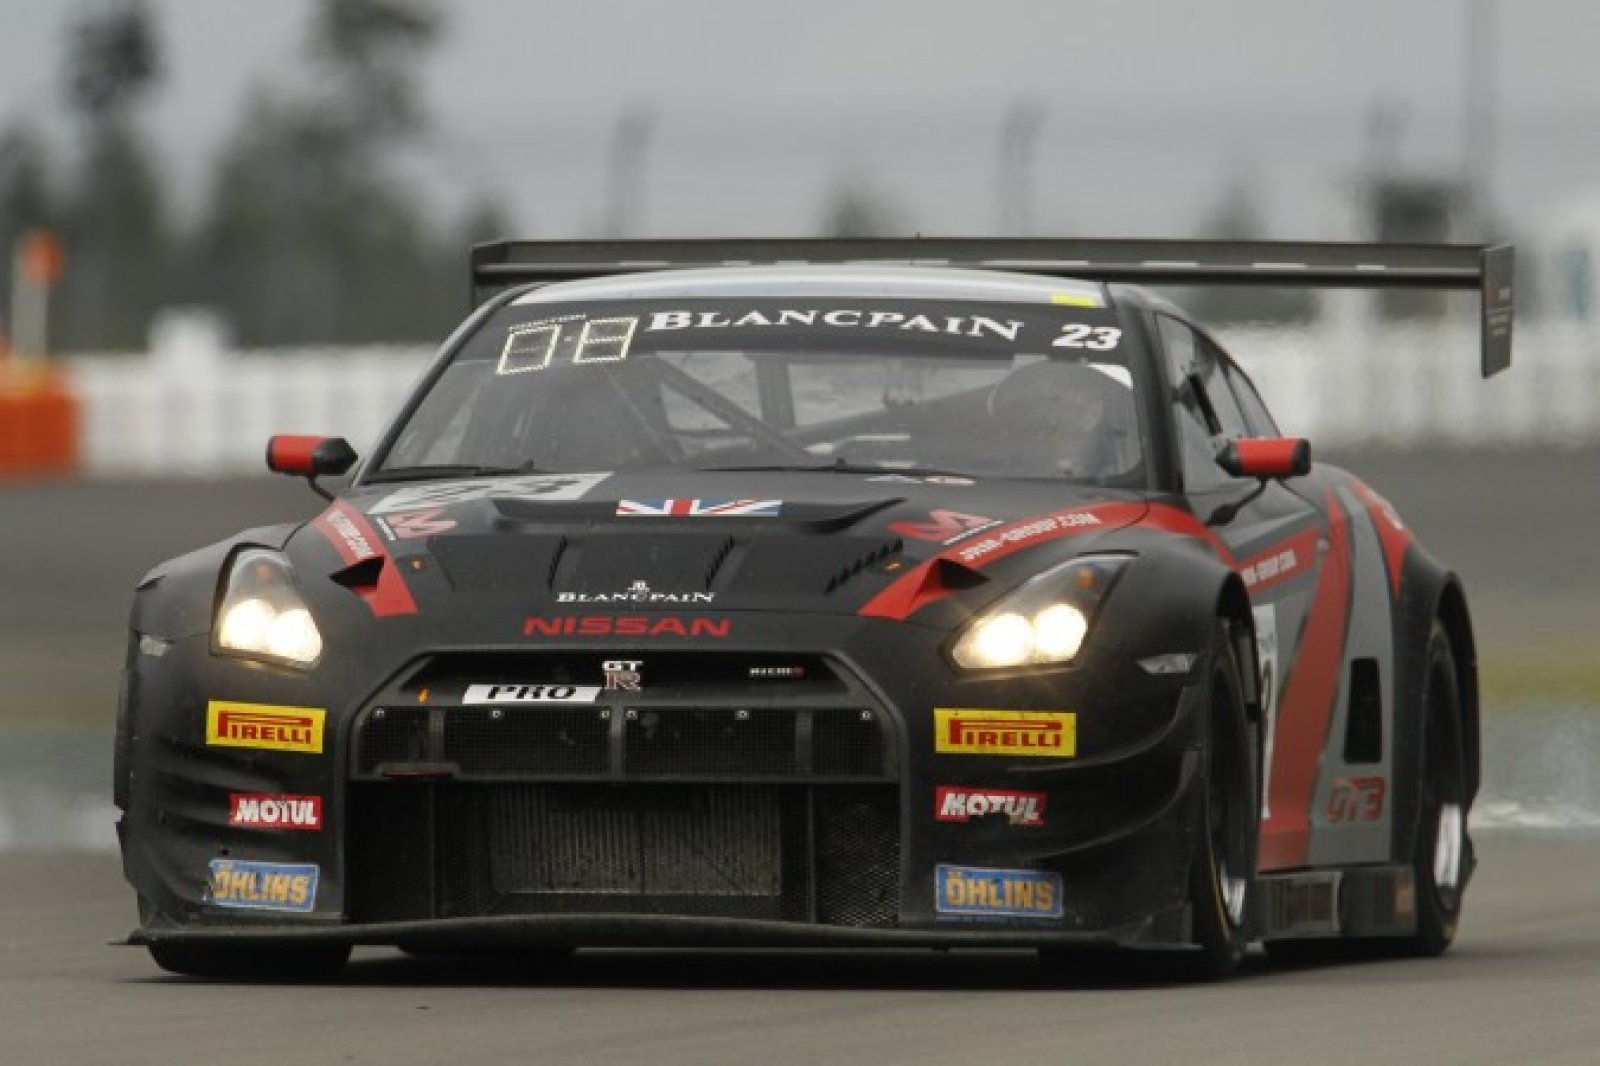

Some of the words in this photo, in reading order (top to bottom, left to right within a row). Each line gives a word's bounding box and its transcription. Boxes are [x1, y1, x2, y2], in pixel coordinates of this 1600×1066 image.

[645, 309, 1024, 341] BLANCPAIN
[1052, 324, 1121, 350] 23
[557, 591, 716, 602] BLANCPAIN
[523, 615, 731, 637] NISSAN
[602, 660, 643, 671] GT
[488, 686, 577, 700] PRO
[605, 671, 641, 690] R
[218, 710, 314, 745] PIRELLI
[948, 718, 1062, 747] PIRELLI
[235, 798, 317, 825] MOTUL
[941, 793, 1039, 820] MOTUL
[1327, 776, 1387, 822] GT3
[946, 870, 1053, 911] ÖHLINS
